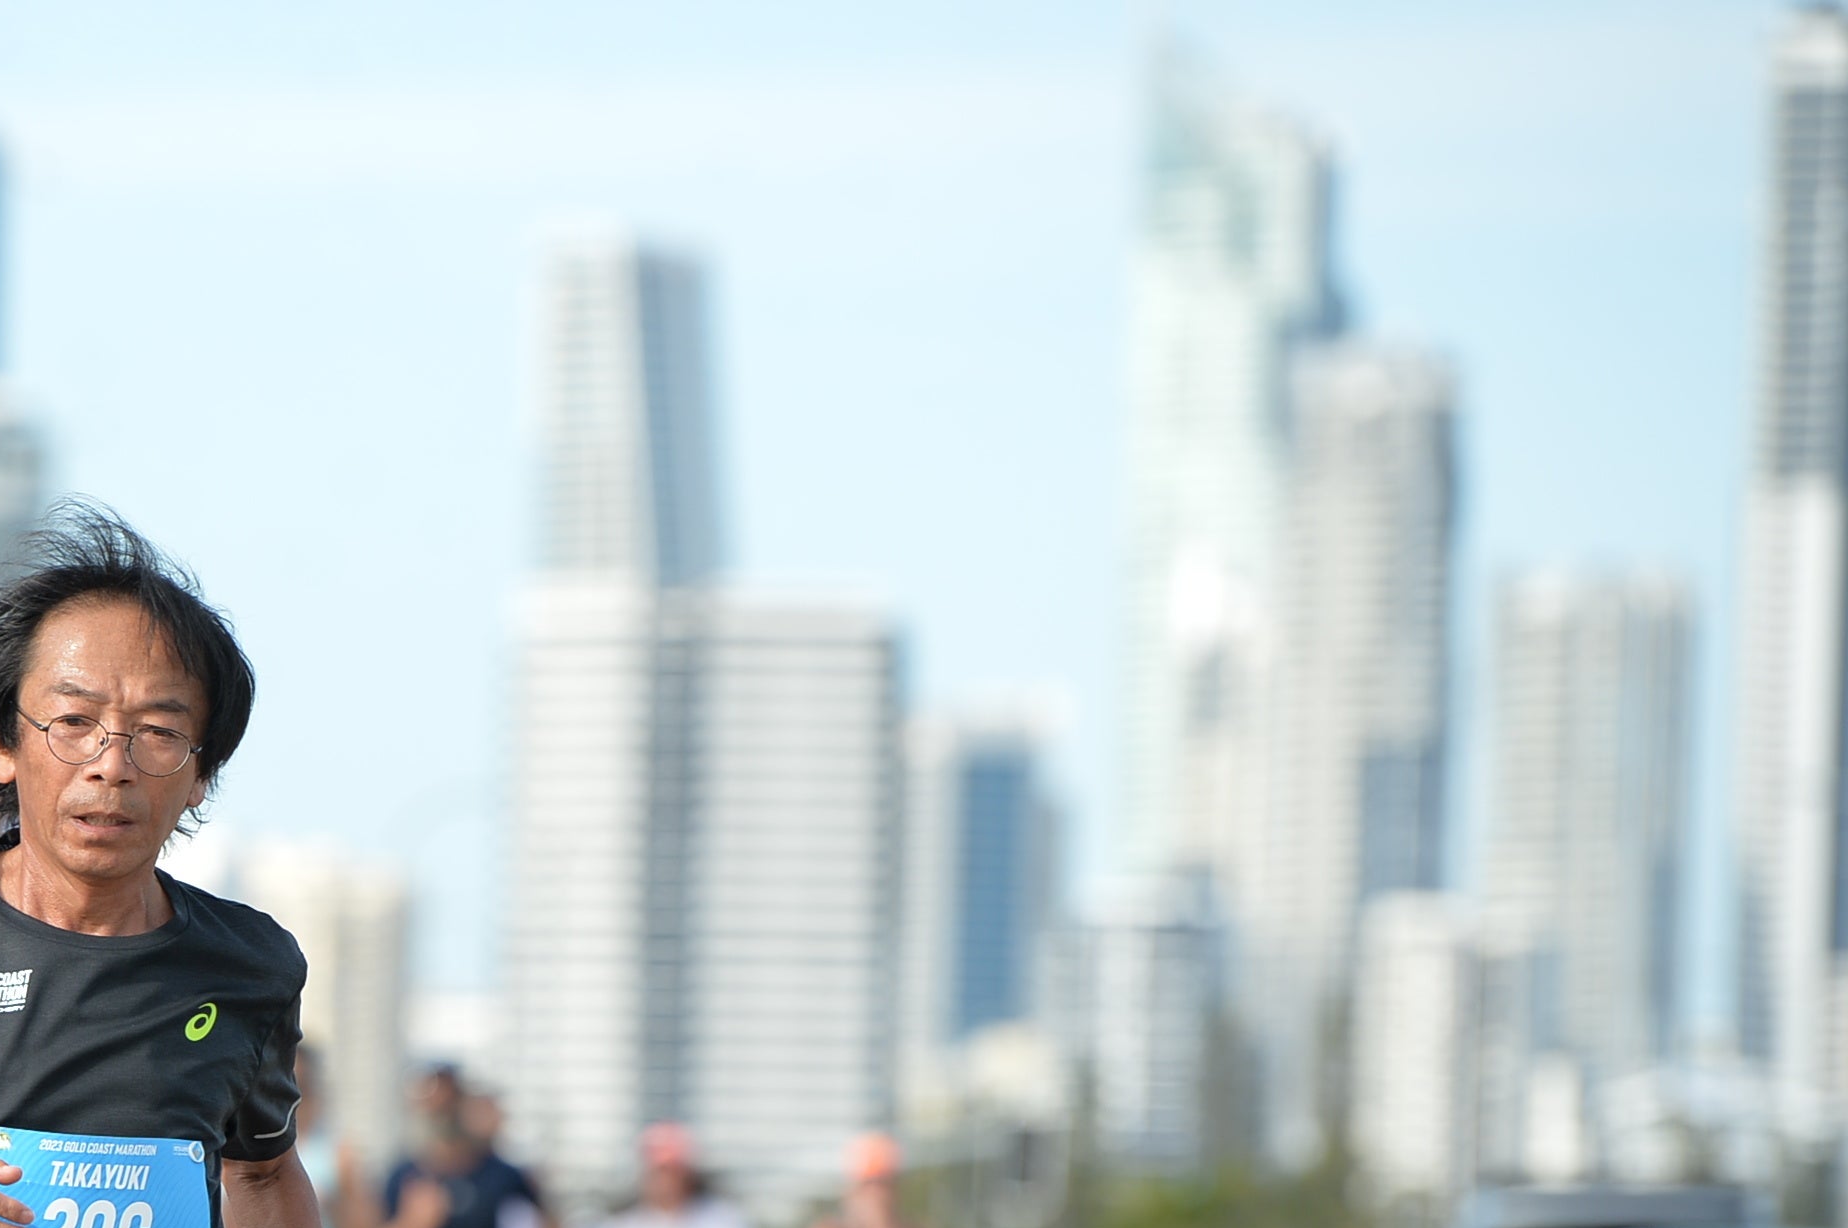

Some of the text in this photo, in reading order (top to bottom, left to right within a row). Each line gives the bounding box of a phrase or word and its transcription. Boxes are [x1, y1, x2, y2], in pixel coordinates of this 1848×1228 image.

[39, 1139, 63, 1151] 2023
[63, 1141, 87, 1153] GOLD
[87, 1142, 115, 1155] COAST
[115, 1144, 158, 1156] MARATHON
[49, 1160, 150, 1190] TAKAYUKI
